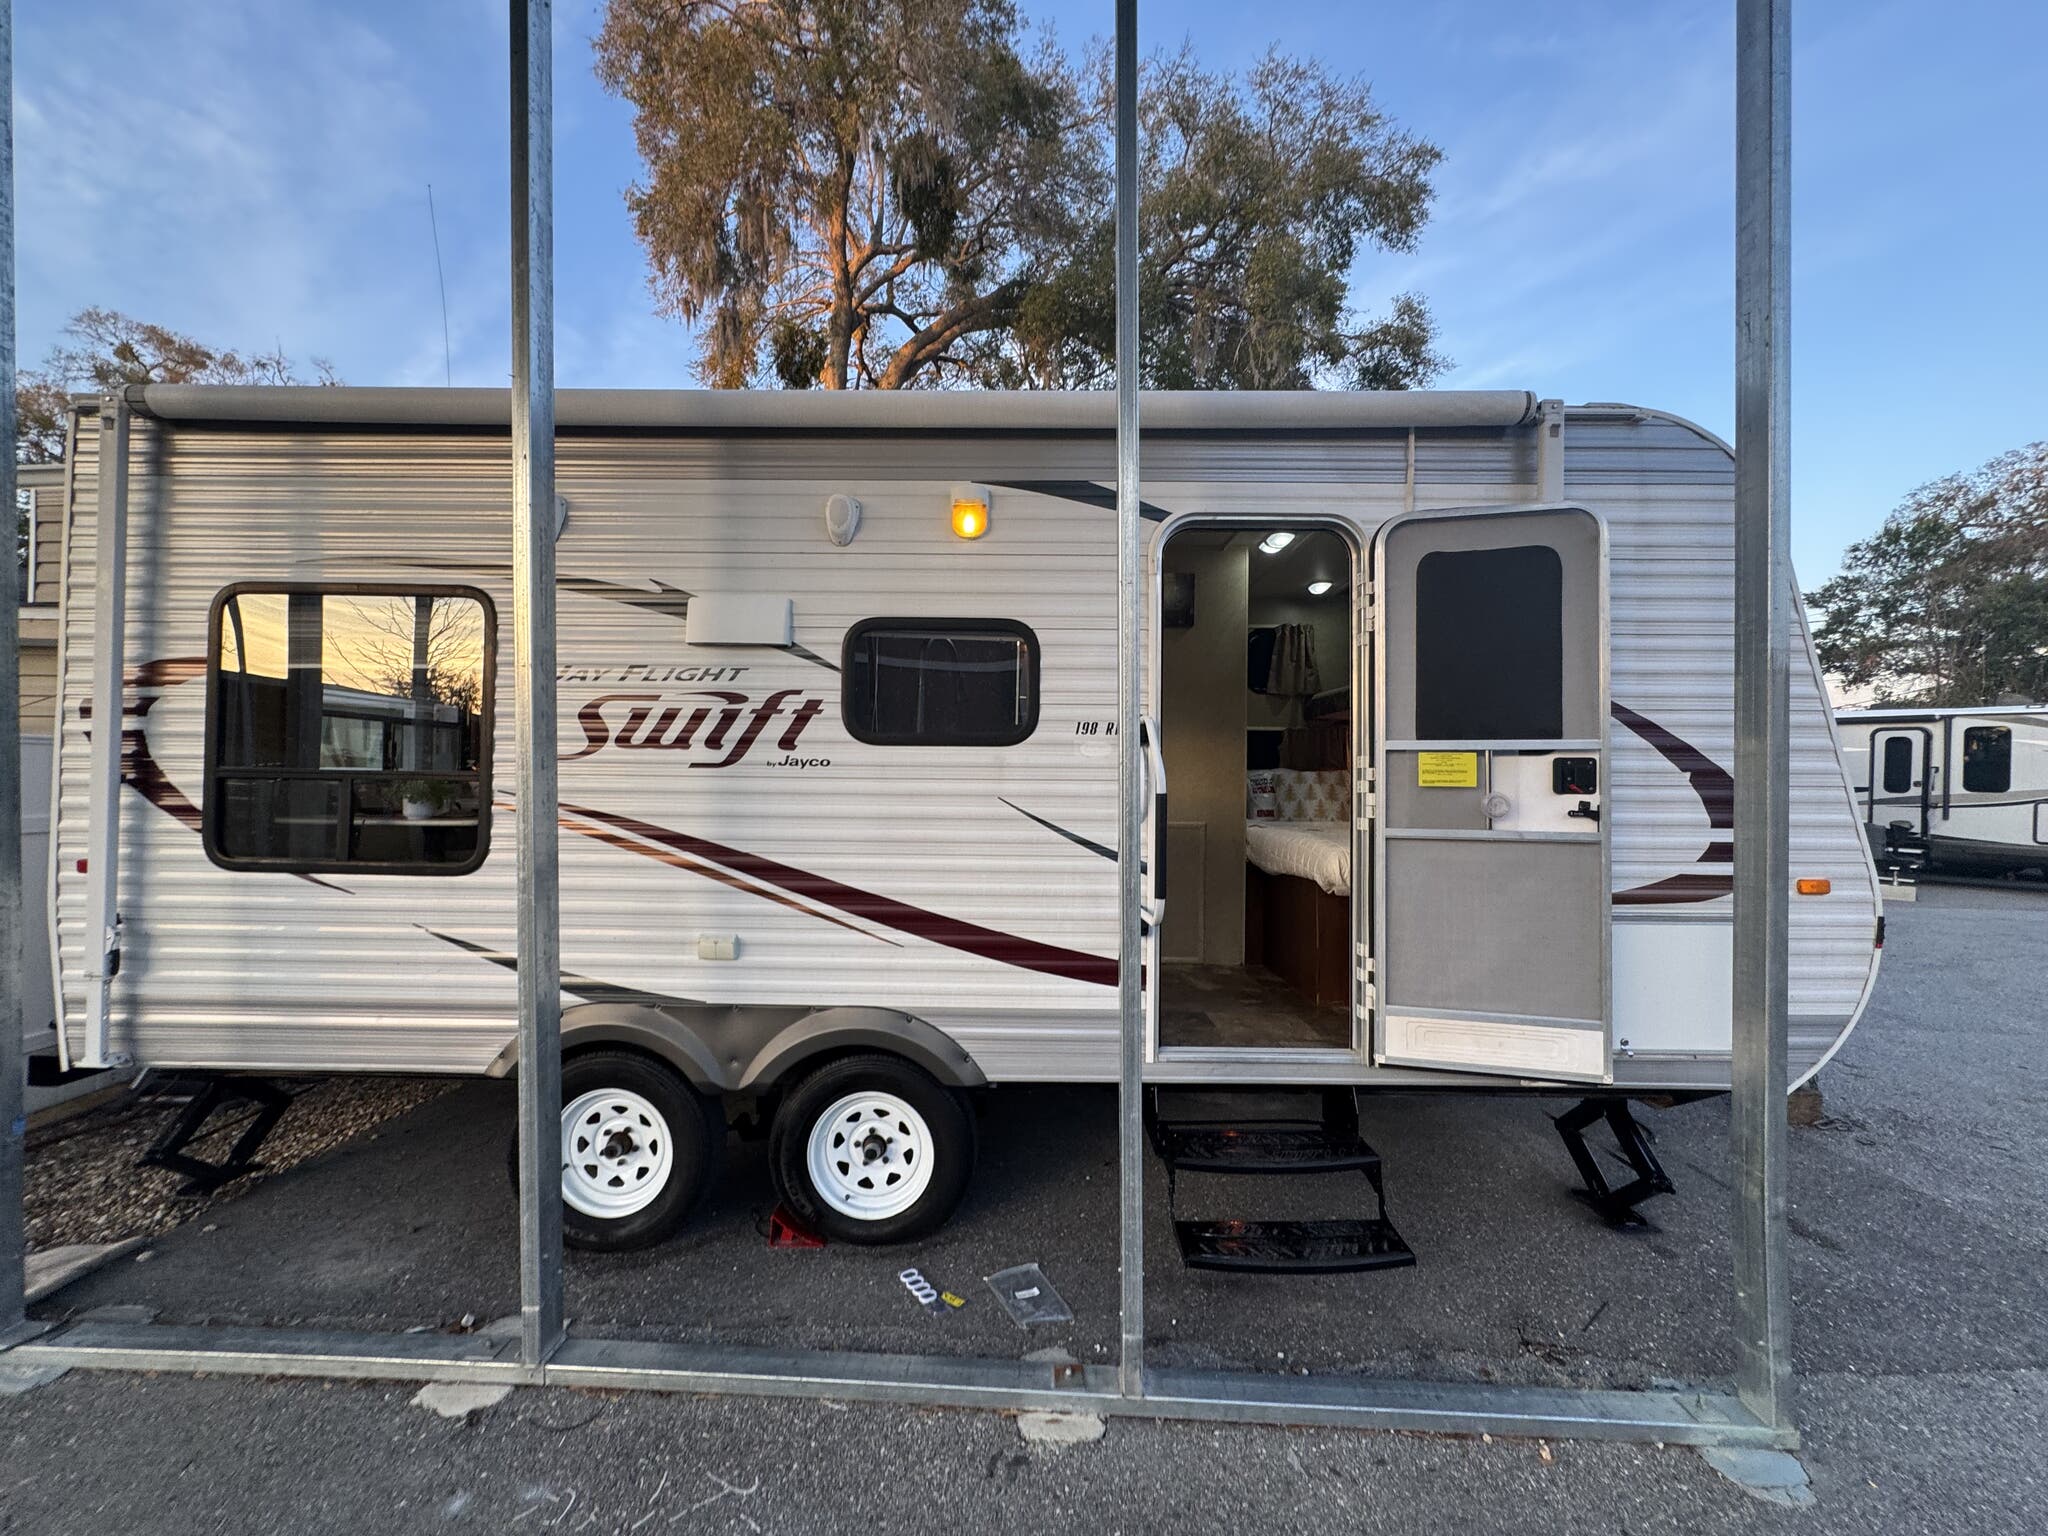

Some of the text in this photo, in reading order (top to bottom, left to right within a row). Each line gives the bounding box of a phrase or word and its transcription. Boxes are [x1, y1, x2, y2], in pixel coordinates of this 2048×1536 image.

[618, 664, 750, 682] FLIGHT
[557, 689, 824, 768] Swift
[1075, 721, 1118, 735] 198 R
[778, 754, 831, 769] Jayco
